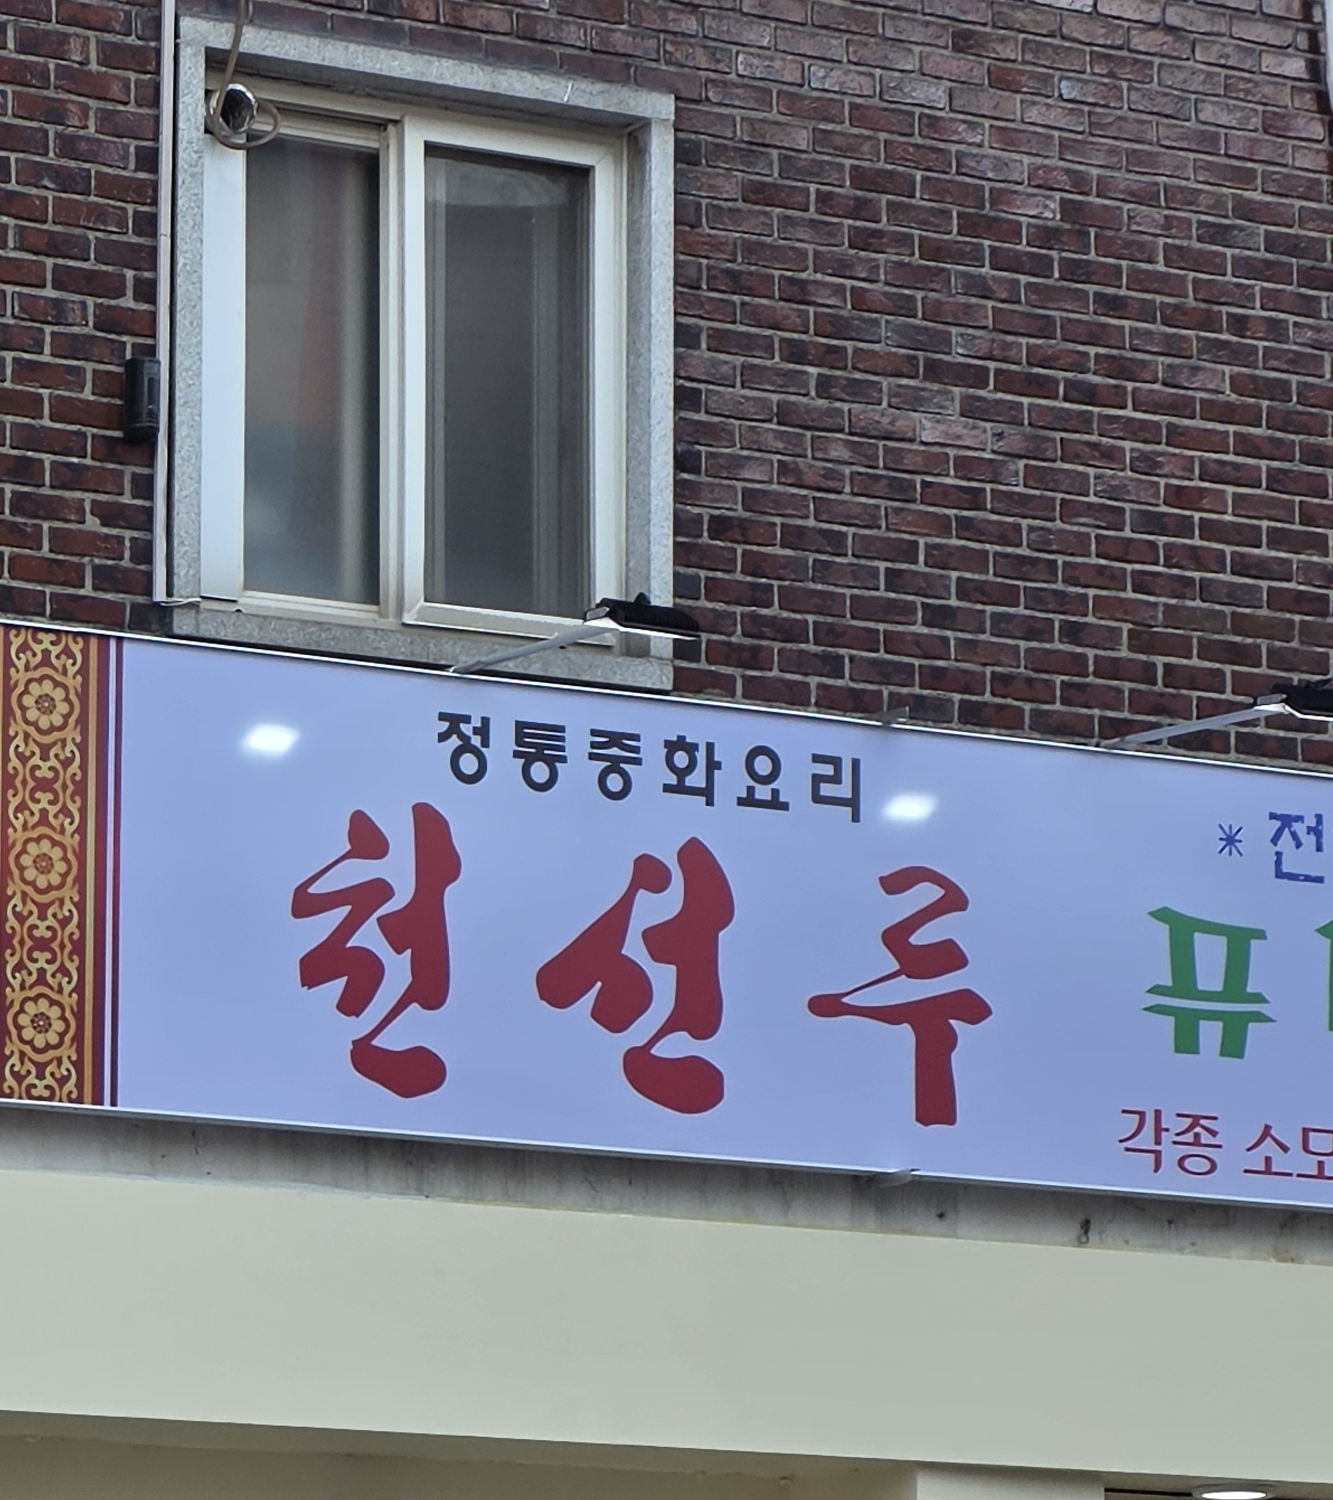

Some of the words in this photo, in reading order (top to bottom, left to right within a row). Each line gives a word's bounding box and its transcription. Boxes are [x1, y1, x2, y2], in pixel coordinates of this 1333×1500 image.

[437, 711, 862, 822] 정통중화요리
[291, 802, 993, 1127] 천선루
[1118, 1109, 1224, 1177] 각종
